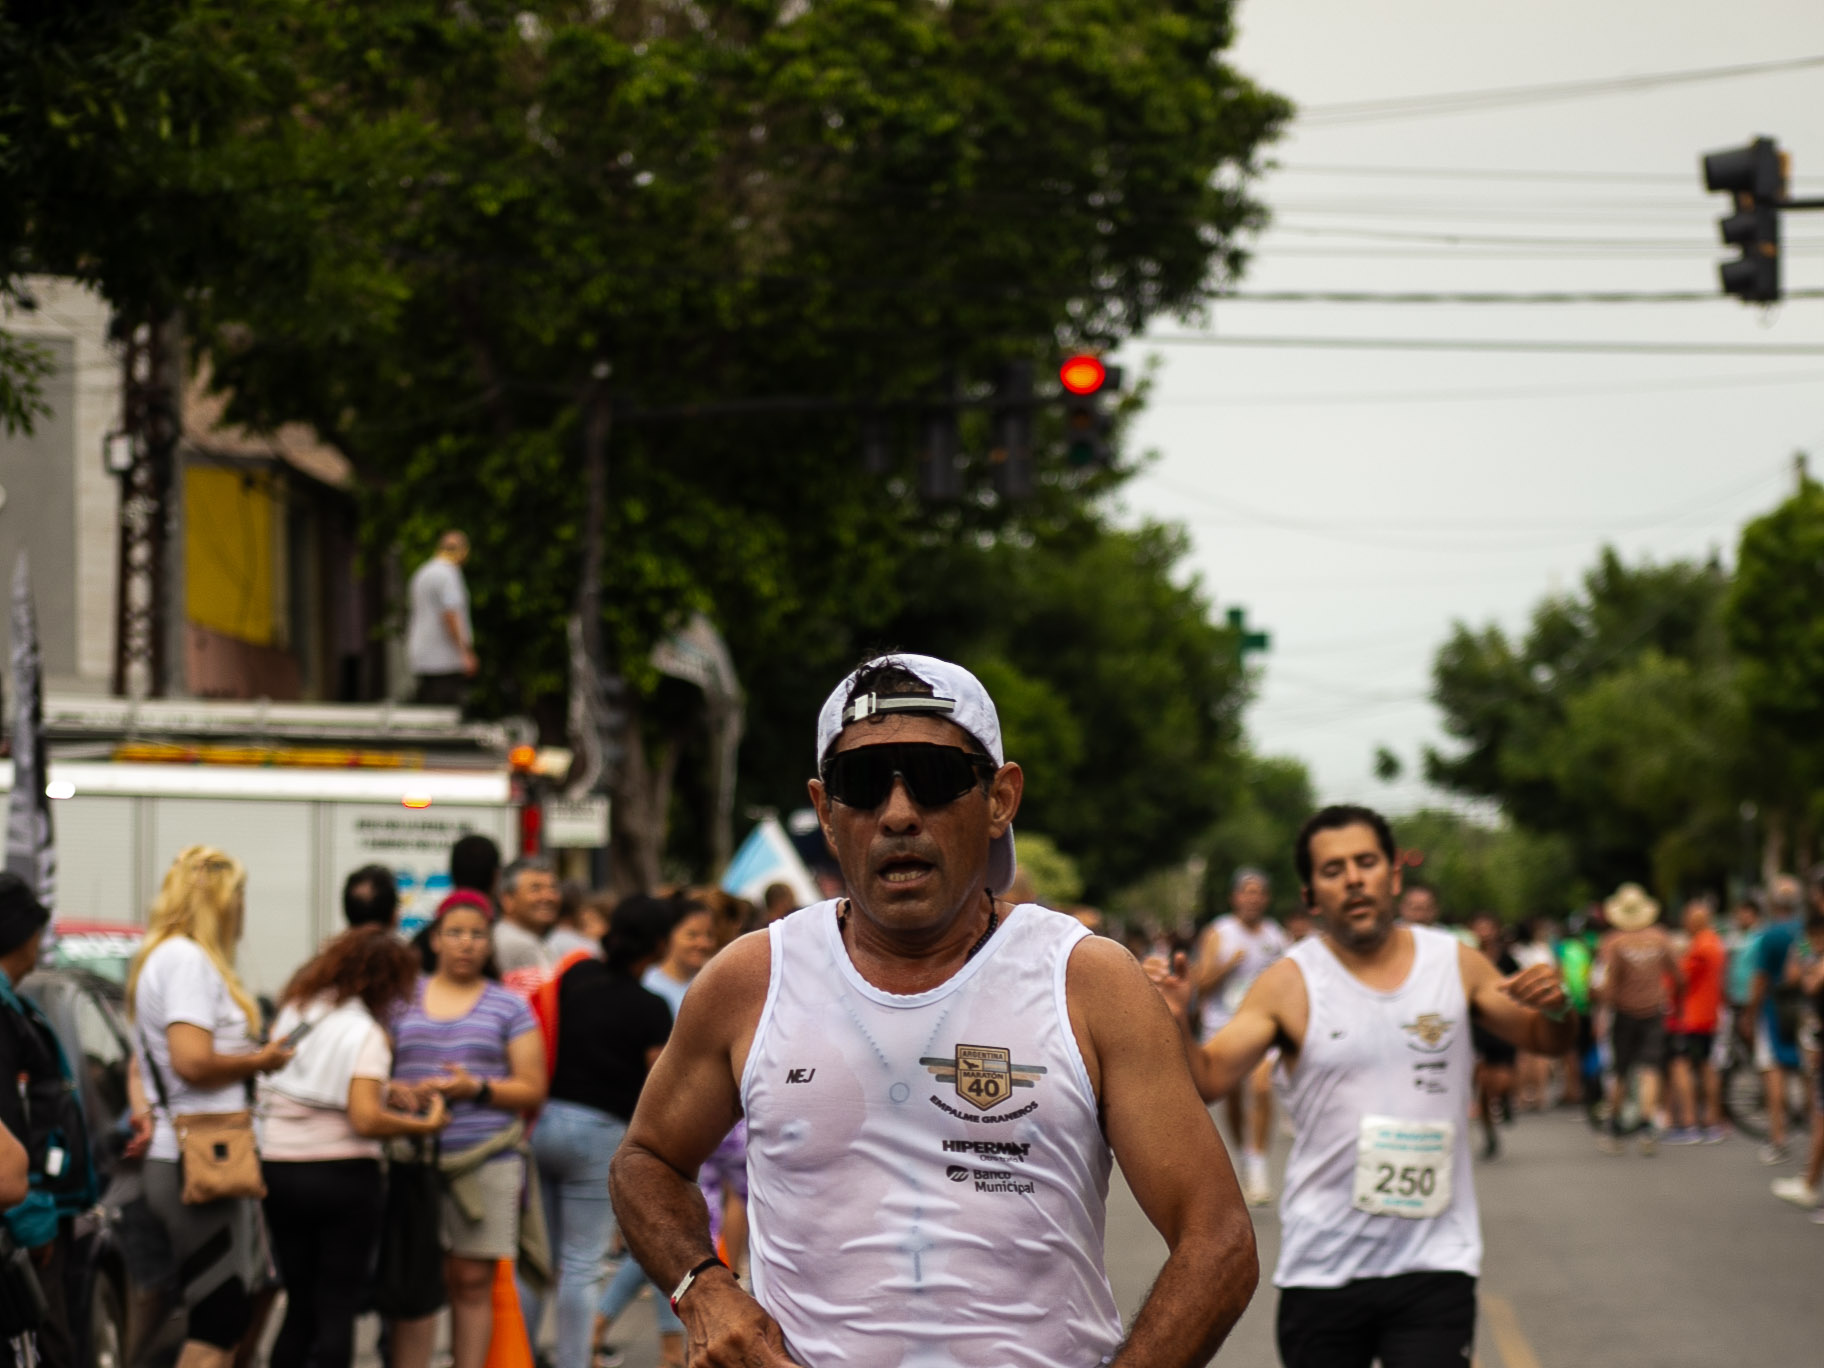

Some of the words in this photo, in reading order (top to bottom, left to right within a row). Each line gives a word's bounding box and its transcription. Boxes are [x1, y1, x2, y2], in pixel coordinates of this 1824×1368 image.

[968, 1079, 1000, 1098] 40
[929, 1094, 980, 1123] EMPALME
[981, 1100, 1038, 1124] GRANEROS
[973, 1169, 1012, 1180] Banco
[1376, 1162, 1436, 1197] 250
[975, 1181, 1035, 1195] Municipal
